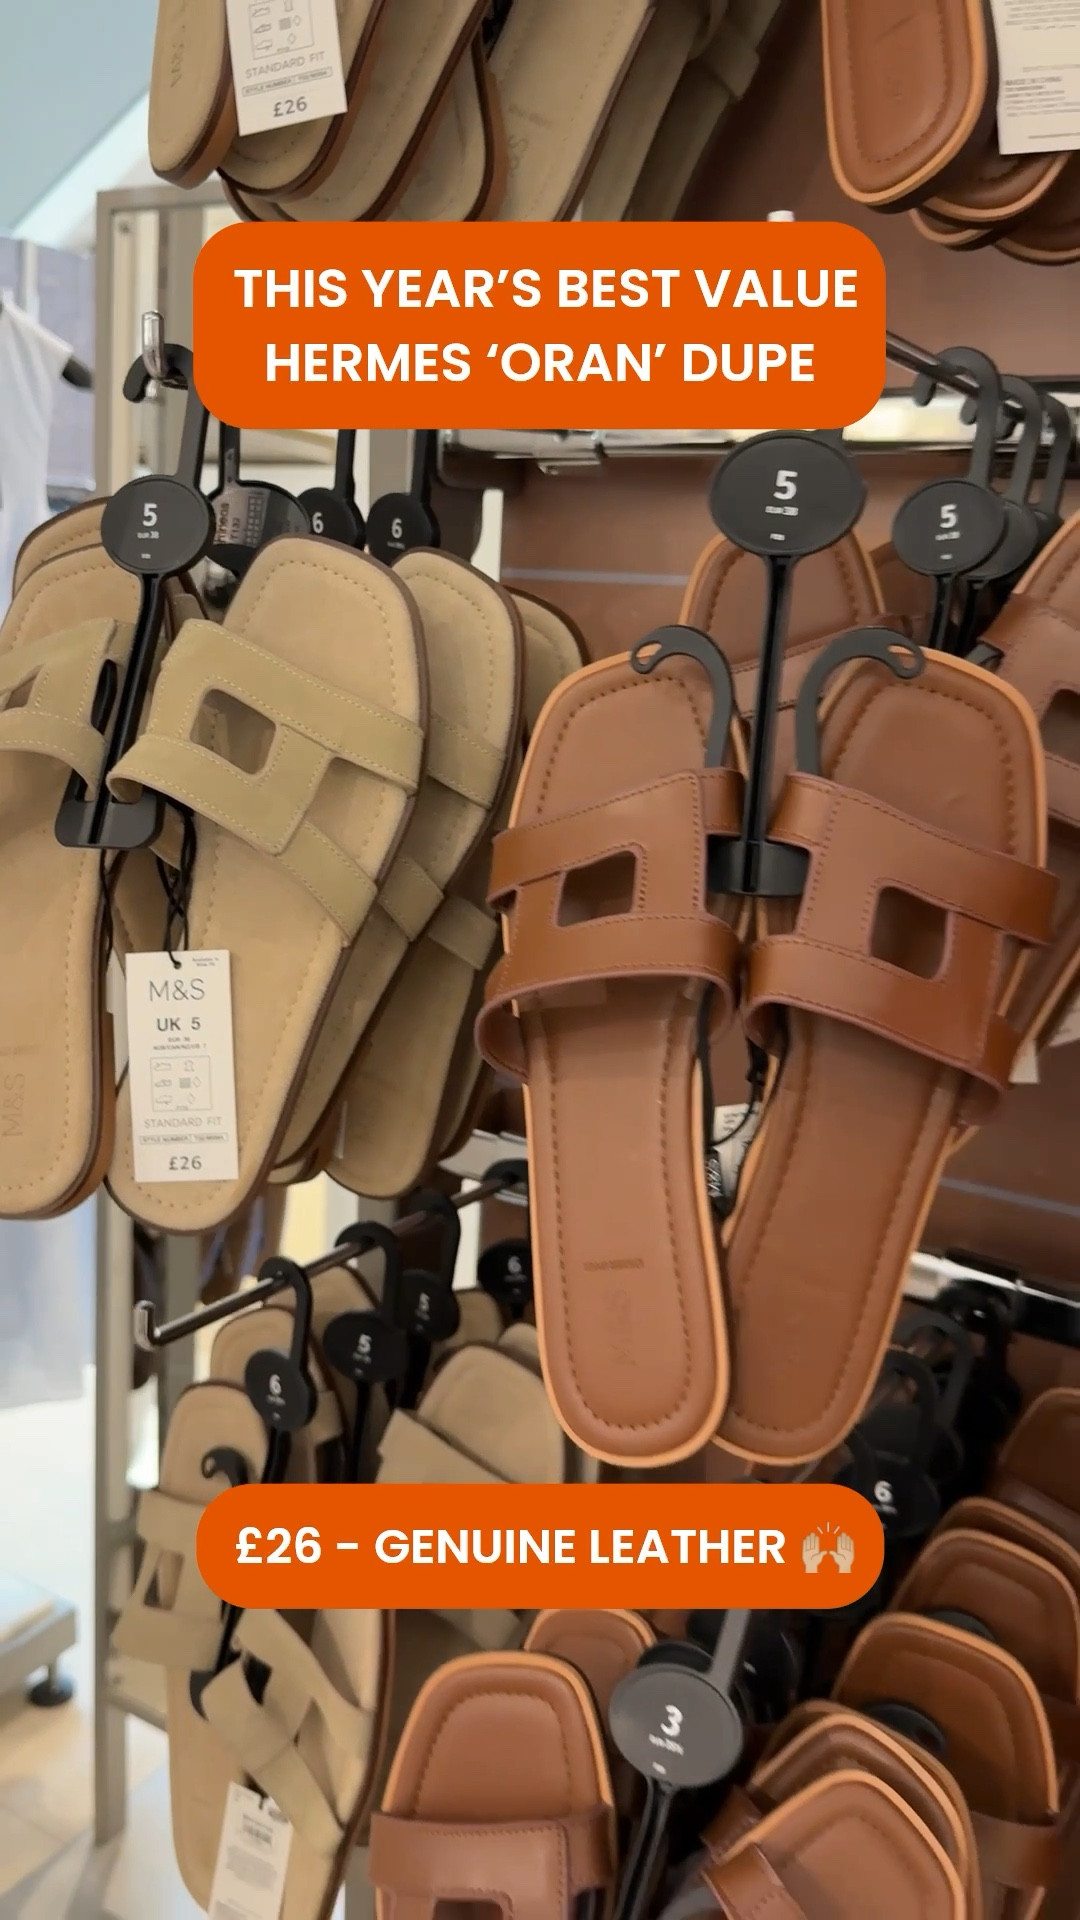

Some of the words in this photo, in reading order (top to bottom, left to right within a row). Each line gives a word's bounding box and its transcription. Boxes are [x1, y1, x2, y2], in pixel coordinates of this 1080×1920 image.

[245, 56, 305, 79] STANDARD
[309, 51, 325, 62] FIT
[273, 96, 308, 117] £26
[773, 469, 798, 500] 5
[142, 503, 157, 527] 5
[312, 512, 324, 534] 6
[939, 504, 957, 528] 5
[391, 518, 402, 539] 6
[148, 978, 205, 1001] M&S
[157, 1017, 181, 1031] UK
[191, 1017, 201, 1030] 5
[1, 1073, 24, 1136] M&S
[144, 1117, 202, 1128] STANDARD
[206, 1116, 222, 1126] FIT
[169, 1155, 202, 1170] £26
[357, 1333, 371, 1354] 5
[269, 1374, 282, 1396] 6
[874, 1480, 893, 1504] 6
[660, 1704, 683, 1737] 3
